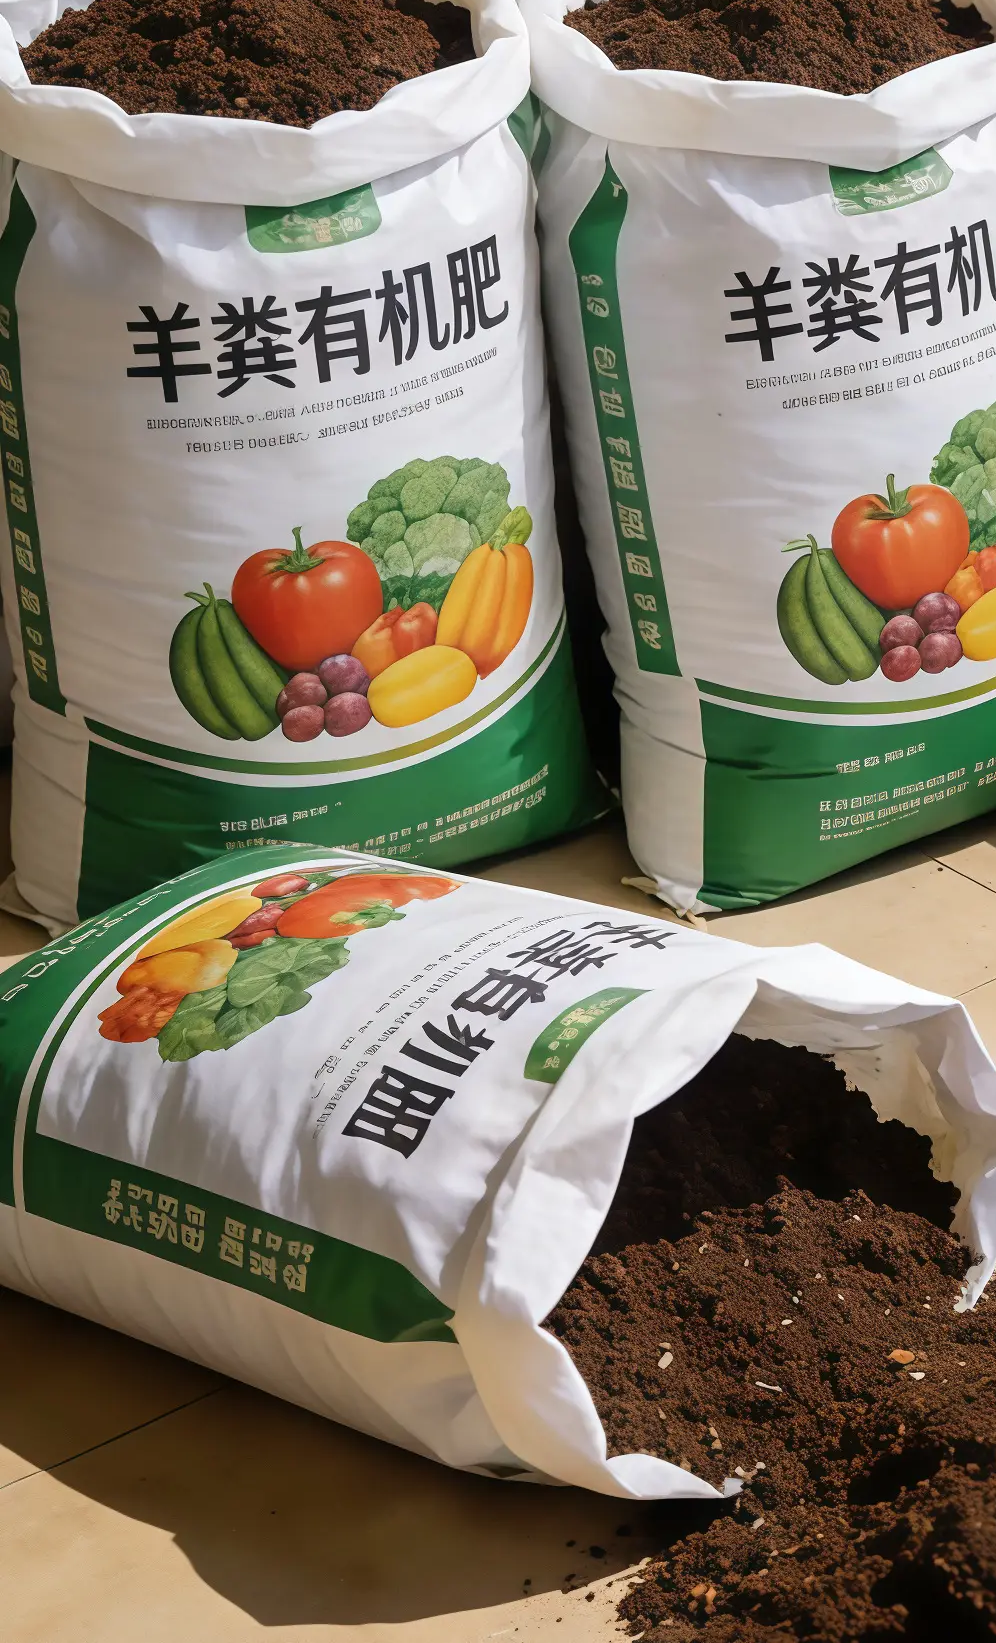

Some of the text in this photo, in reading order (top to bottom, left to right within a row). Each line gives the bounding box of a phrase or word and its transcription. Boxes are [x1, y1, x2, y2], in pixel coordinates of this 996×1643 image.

[126, 234, 509, 404] 羊粪有机肥
